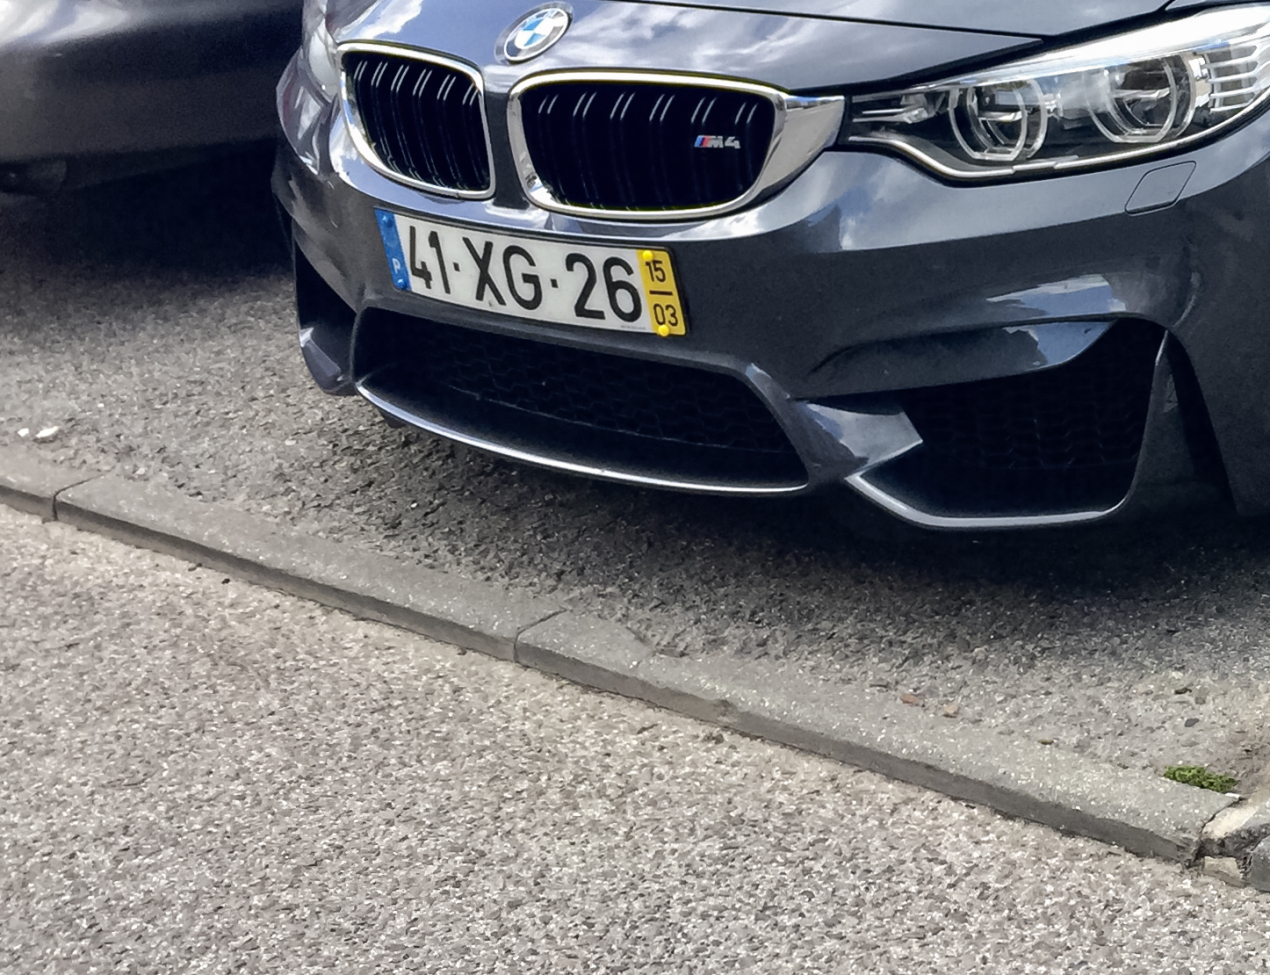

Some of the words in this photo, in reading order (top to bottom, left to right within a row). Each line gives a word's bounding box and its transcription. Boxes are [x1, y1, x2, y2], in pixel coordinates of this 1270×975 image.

[704, 135, 741, 149] M4
[392, 258, 401, 274] P
[645, 259, 667, 283] 15
[653, 303, 679, 327] 03
